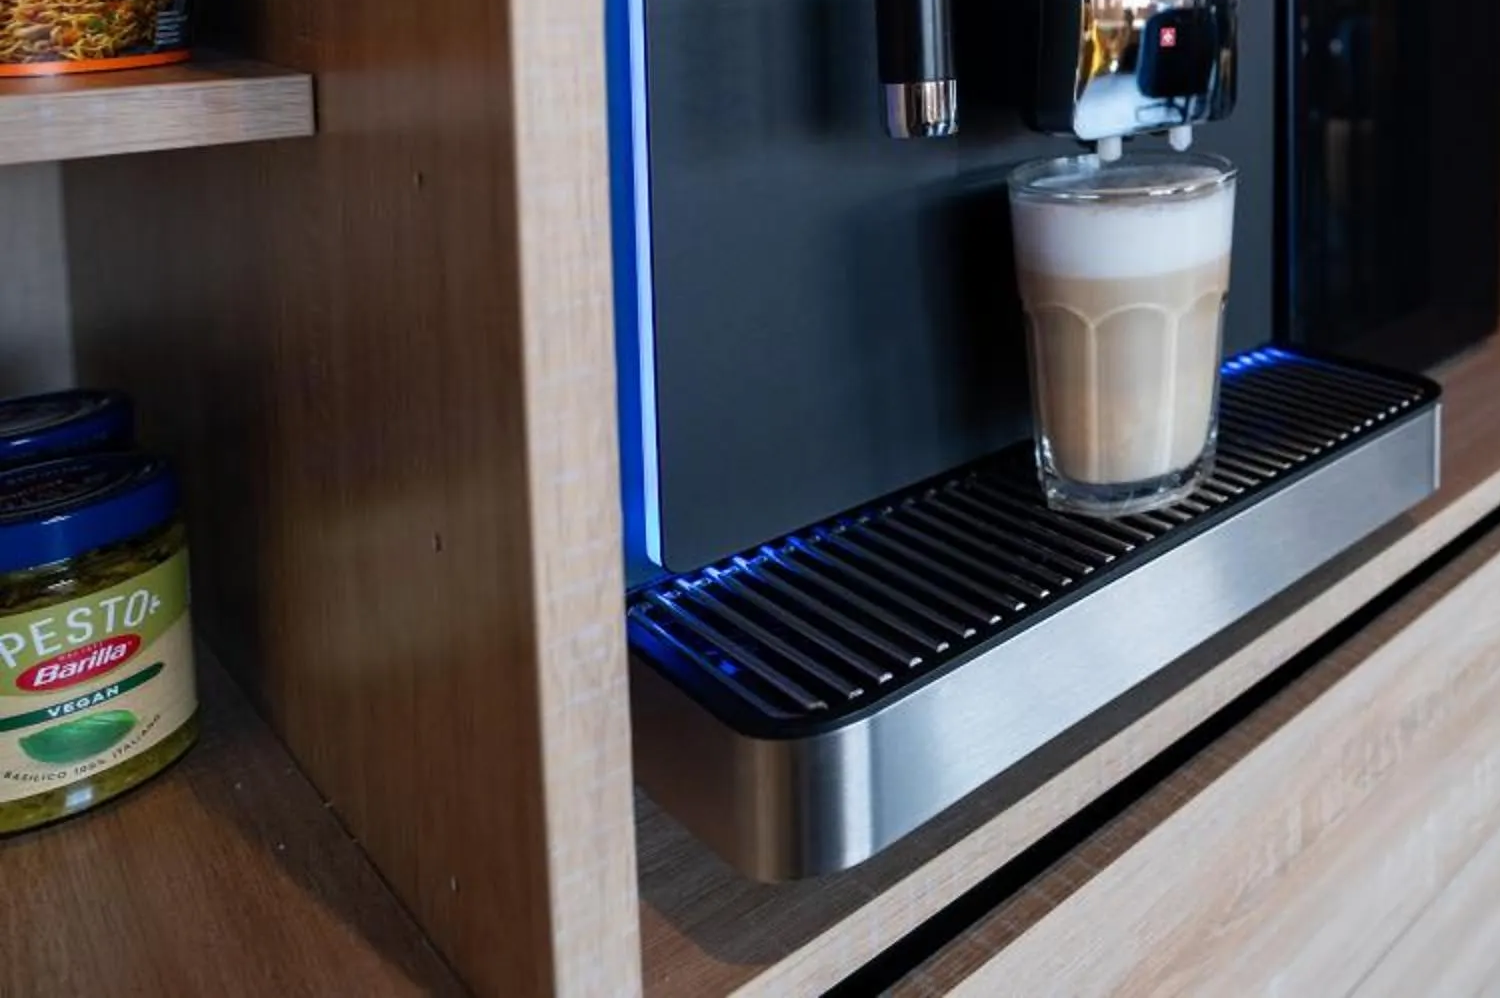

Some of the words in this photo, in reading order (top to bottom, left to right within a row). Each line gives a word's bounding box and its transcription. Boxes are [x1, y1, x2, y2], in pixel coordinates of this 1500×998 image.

[0, 589, 149, 668] PESTO
[33, 643, 127, 687] Barilla
[48, 685, 119, 717] VEGAN
